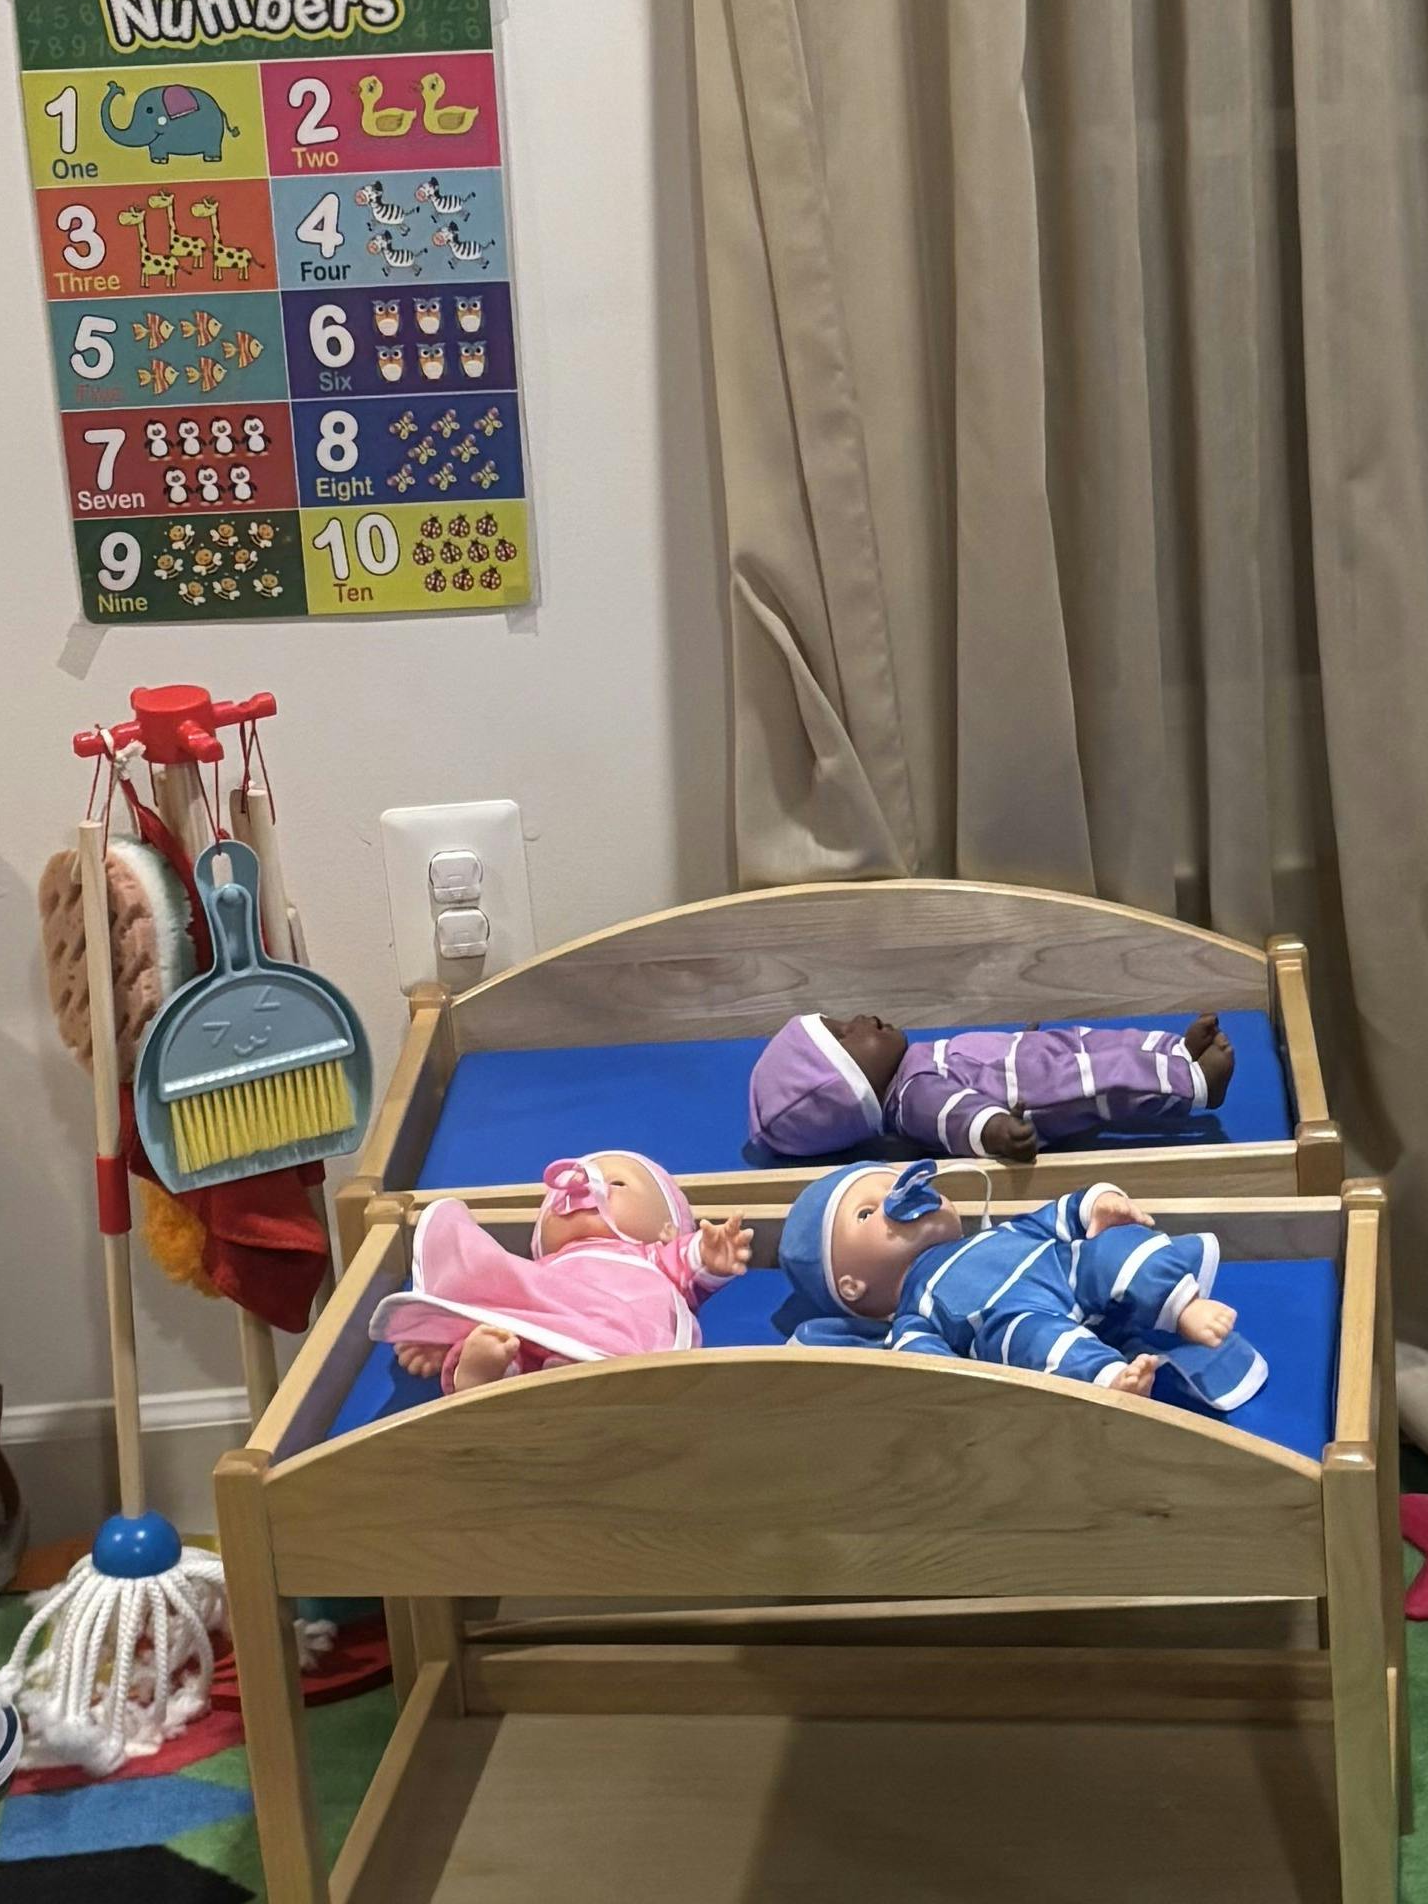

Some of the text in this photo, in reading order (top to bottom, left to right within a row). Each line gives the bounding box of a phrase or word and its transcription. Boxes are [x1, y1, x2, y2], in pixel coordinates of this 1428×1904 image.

[45, 86, 78, 154] 1
[288, 77, 339, 146] 2
[51, 157, 99, 179] One
[290, 146, 339, 169] Two
[55, 205, 105, 271] 3
[296, 191, 344, 258] 4
[54, 270, 121, 294] Three
[300, 259, 352, 283] Four
[70, 314, 118, 380] 5
[308, 303, 356, 369] 6
[318, 370, 353, 393] Six
[84, 427, 127, 492] 7
[315, 409, 360, 473] 8
[76, 489, 146, 512] Seven
[315, 475, 375, 502] Eight
[97, 531, 143, 592] 9
[312, 512, 401, 580] 10
[97, 592, 149, 613] Nine
[332, 583, 374, 605] Ten
